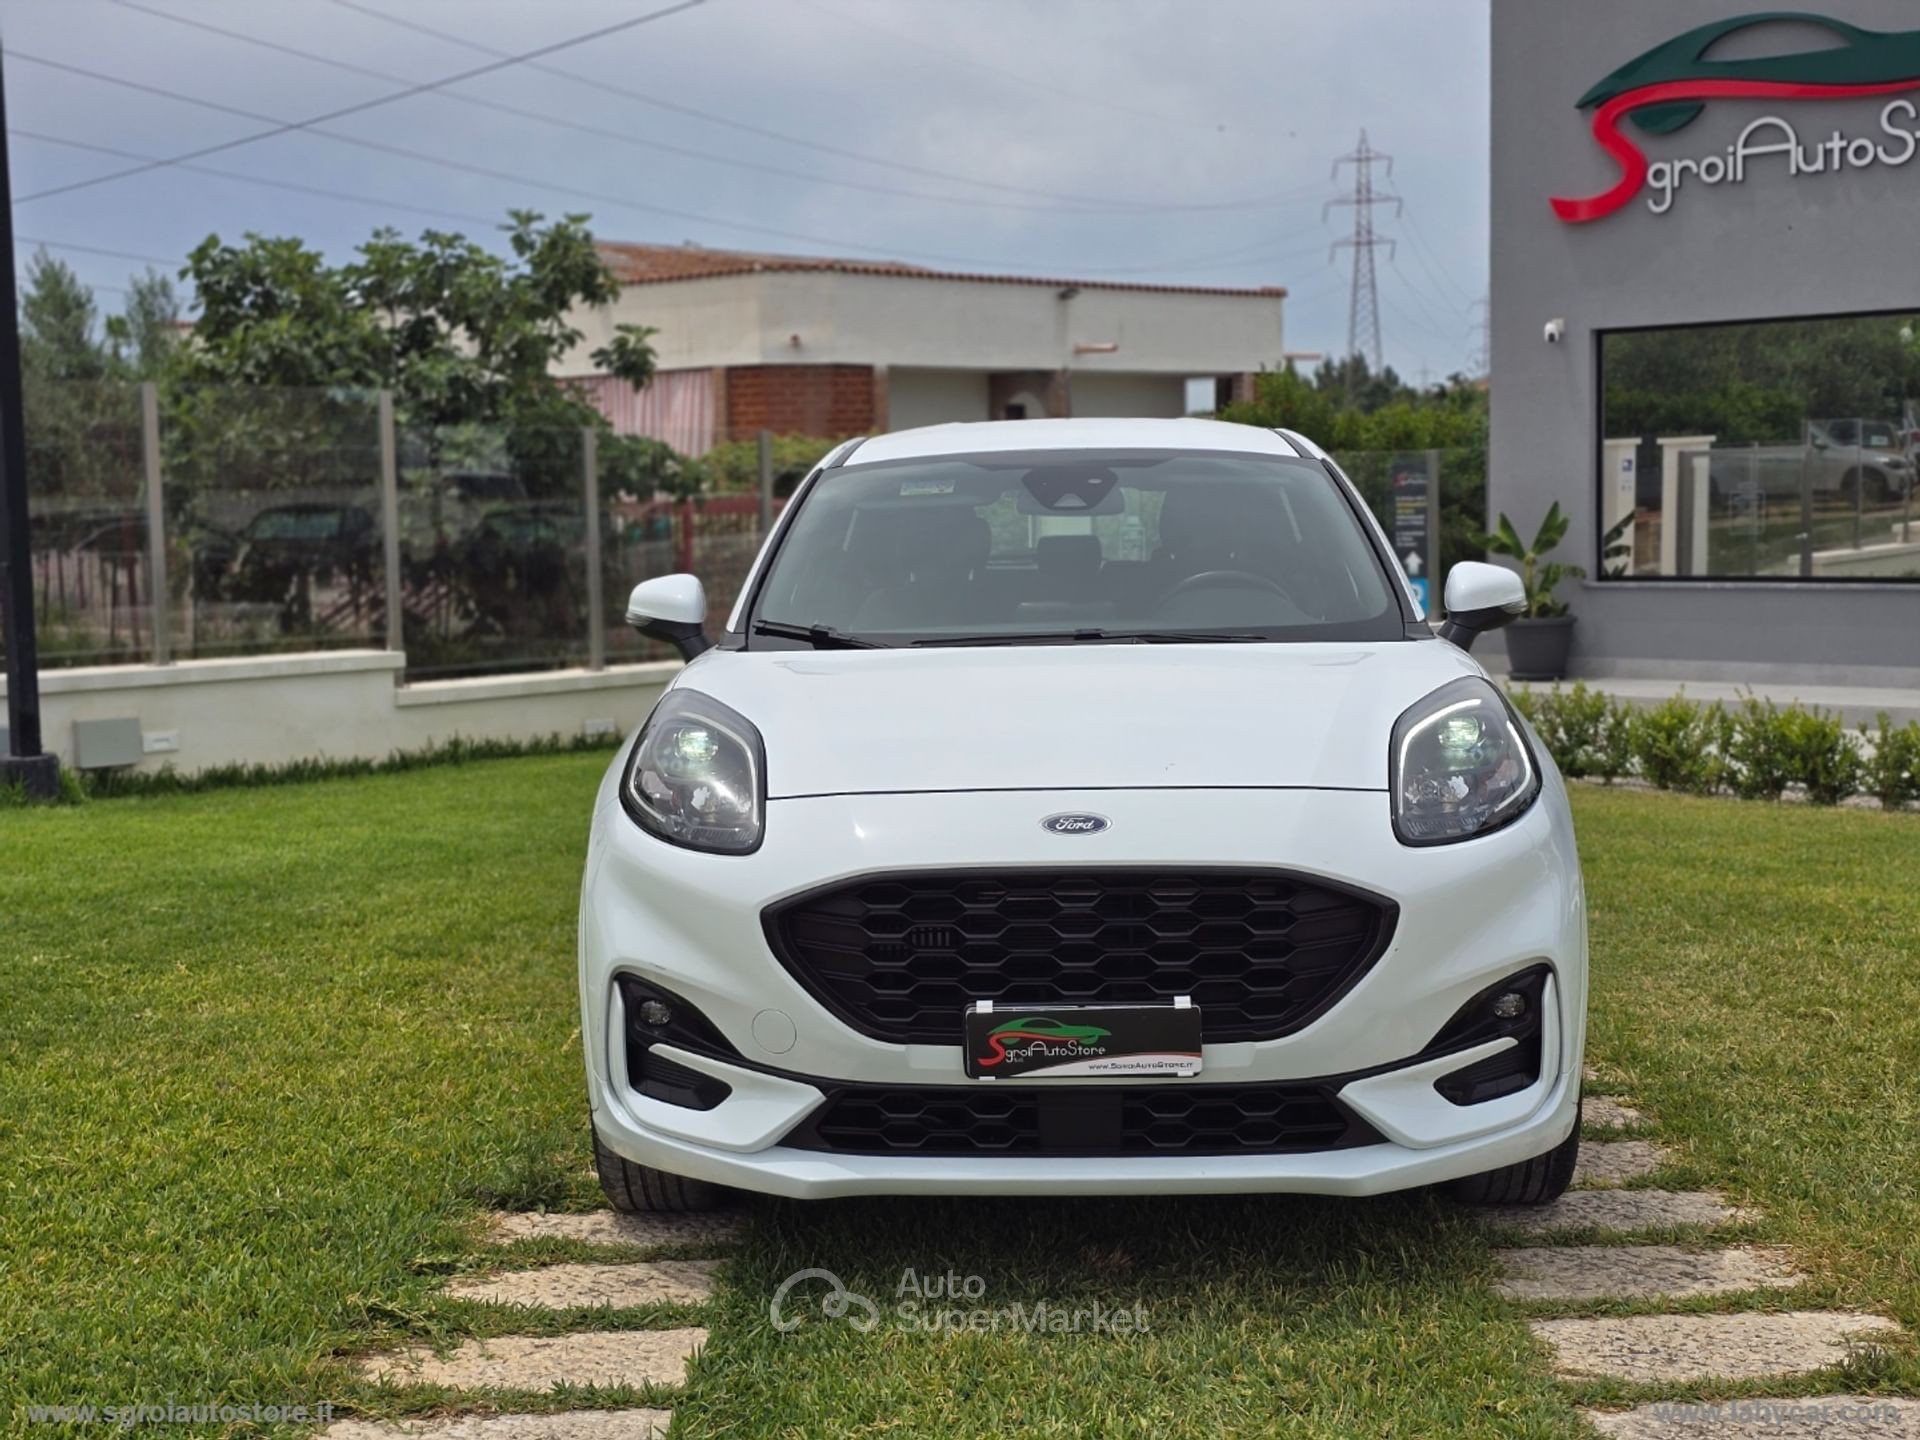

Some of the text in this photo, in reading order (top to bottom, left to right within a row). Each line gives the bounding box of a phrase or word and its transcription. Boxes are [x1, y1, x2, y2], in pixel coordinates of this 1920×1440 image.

[1549, 88, 1920, 223] SgroiAutoS
[1055, 817, 1095, 830] Ford
[977, 1037, 1106, 1067] SgroiAutoStore
